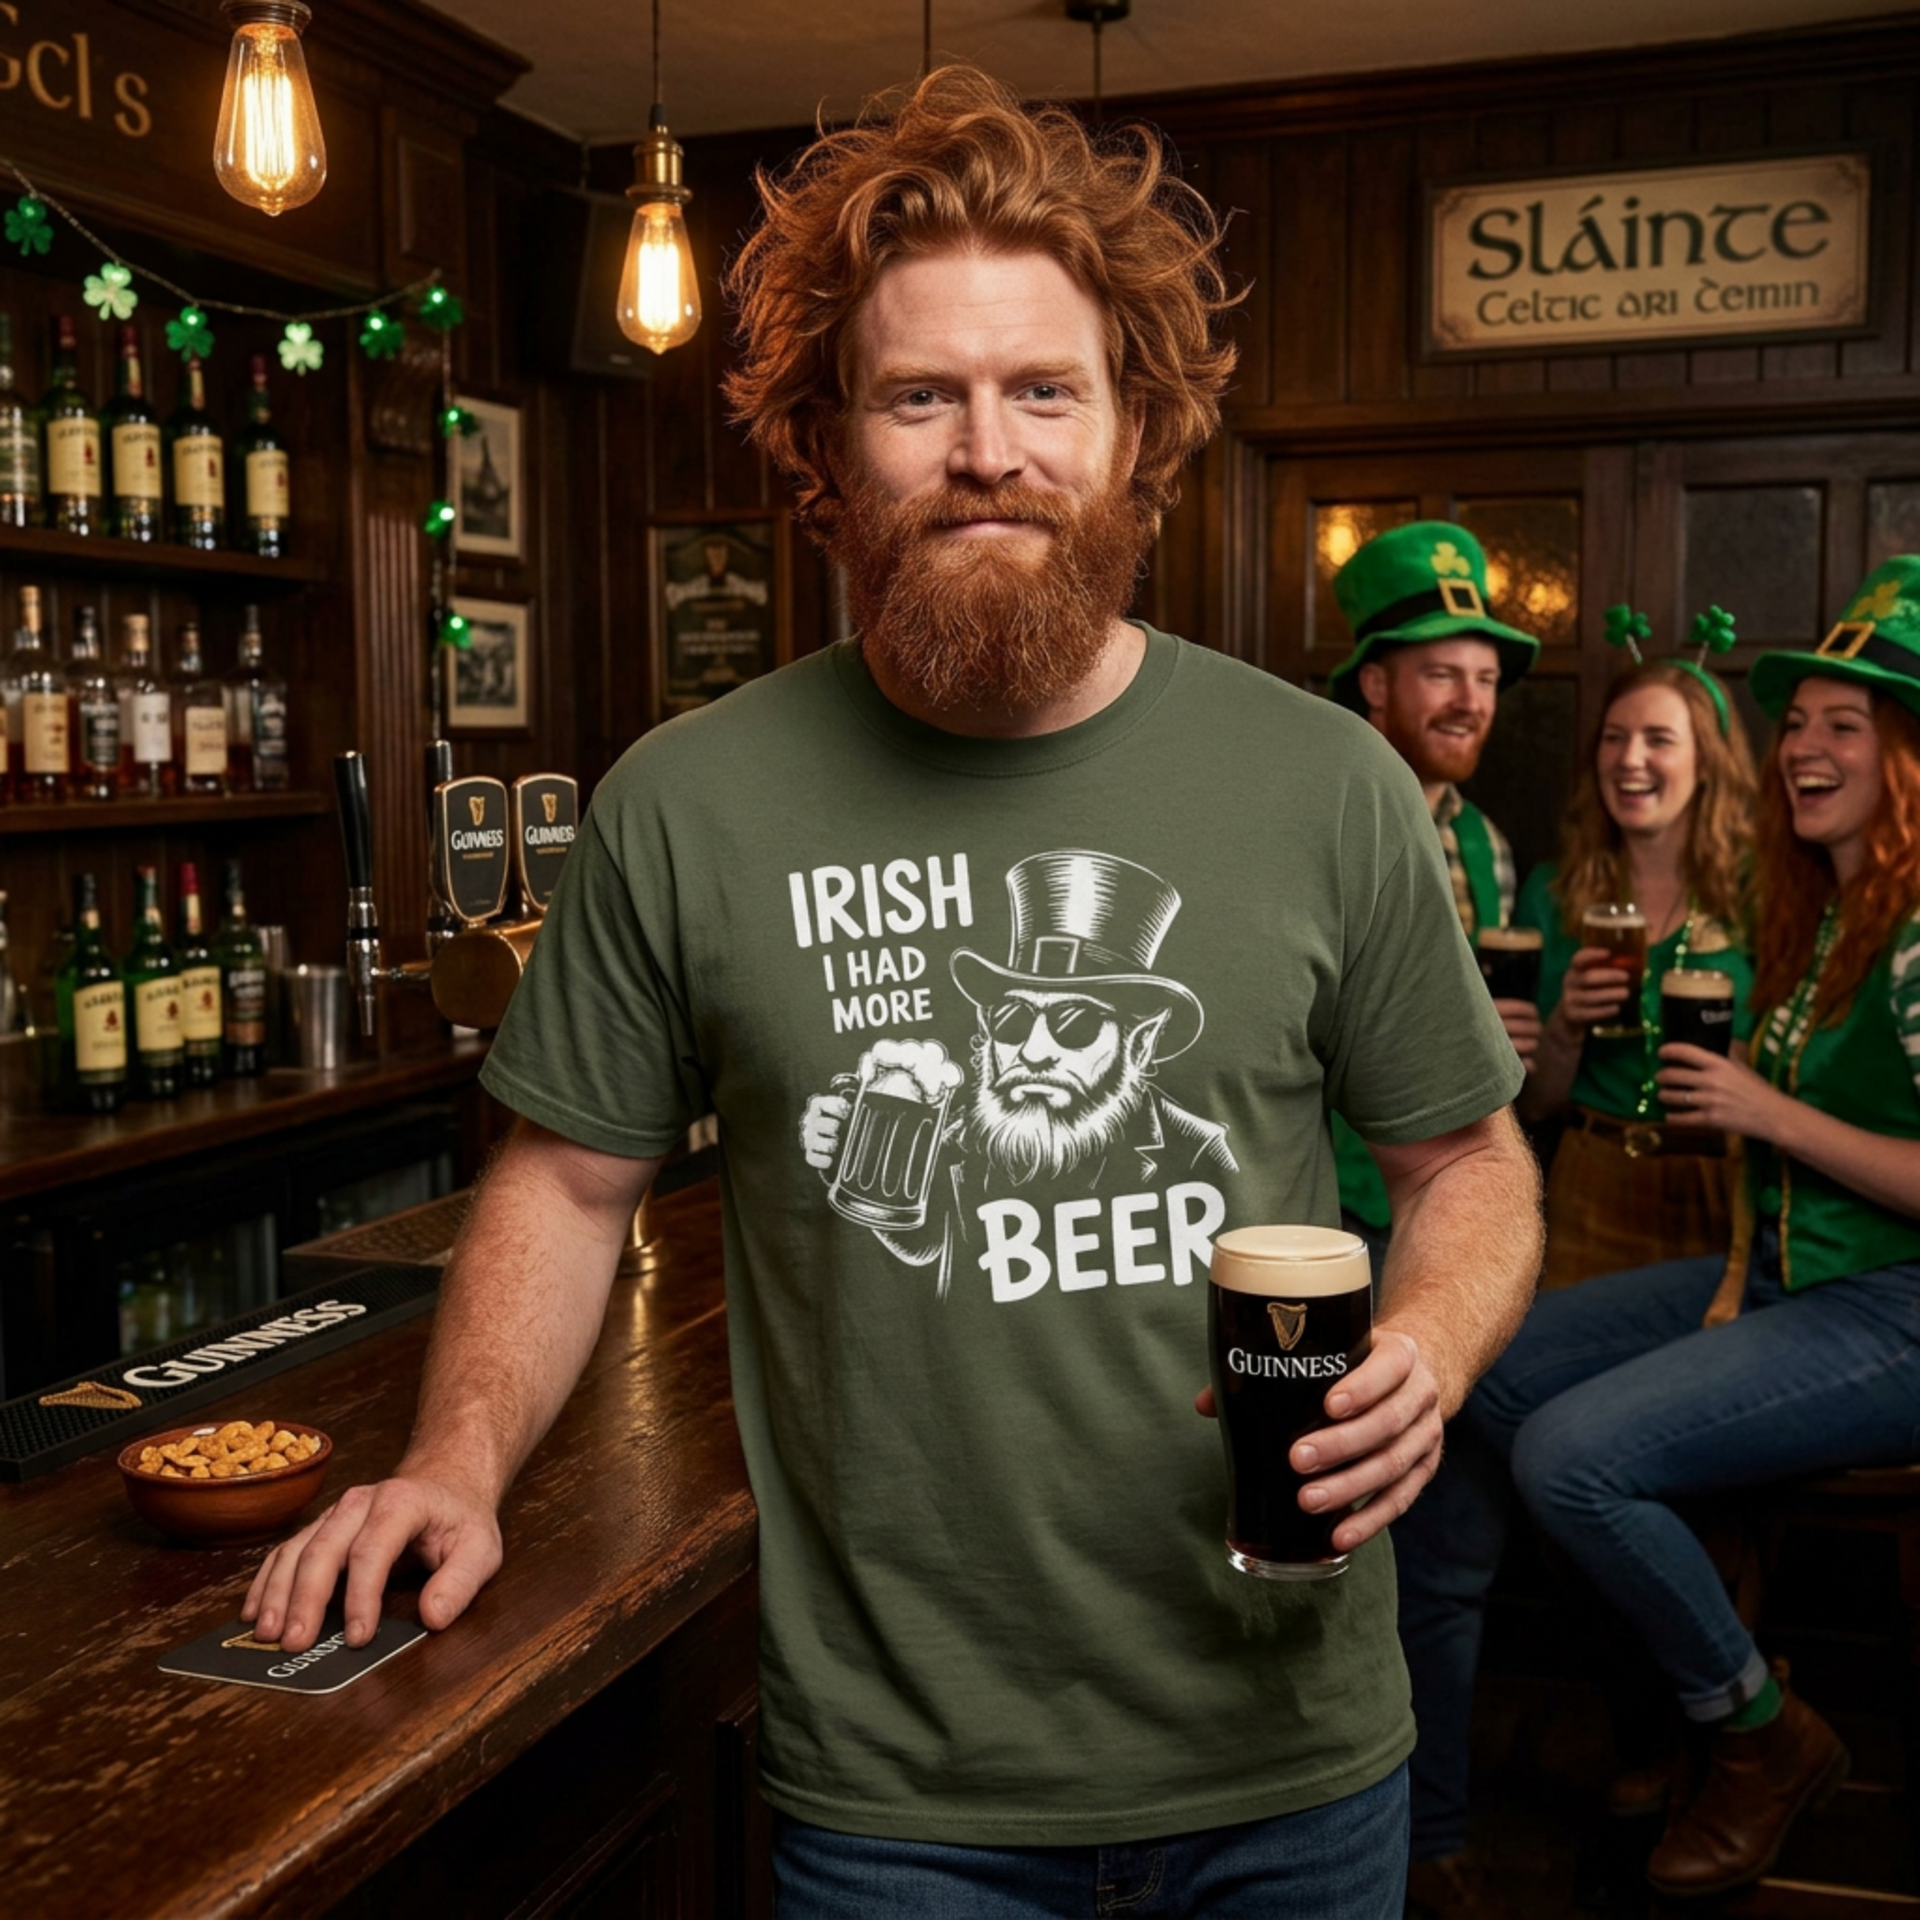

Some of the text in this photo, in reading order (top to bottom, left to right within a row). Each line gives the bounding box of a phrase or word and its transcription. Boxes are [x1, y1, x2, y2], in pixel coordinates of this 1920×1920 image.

[1467, 194, 1831, 280] Sláinte
[1476, 289, 1602, 327] Celtic
[789, 853, 973, 948] IRISH
[823, 946, 927, 992] I HAD
[831, 988, 933, 1034] MORE
[976, 1181, 1226, 1303] BEER
[122, 1299, 367, 1388] GUINNESS
[1228, 1347, 1347, 1378] GUINNESS
